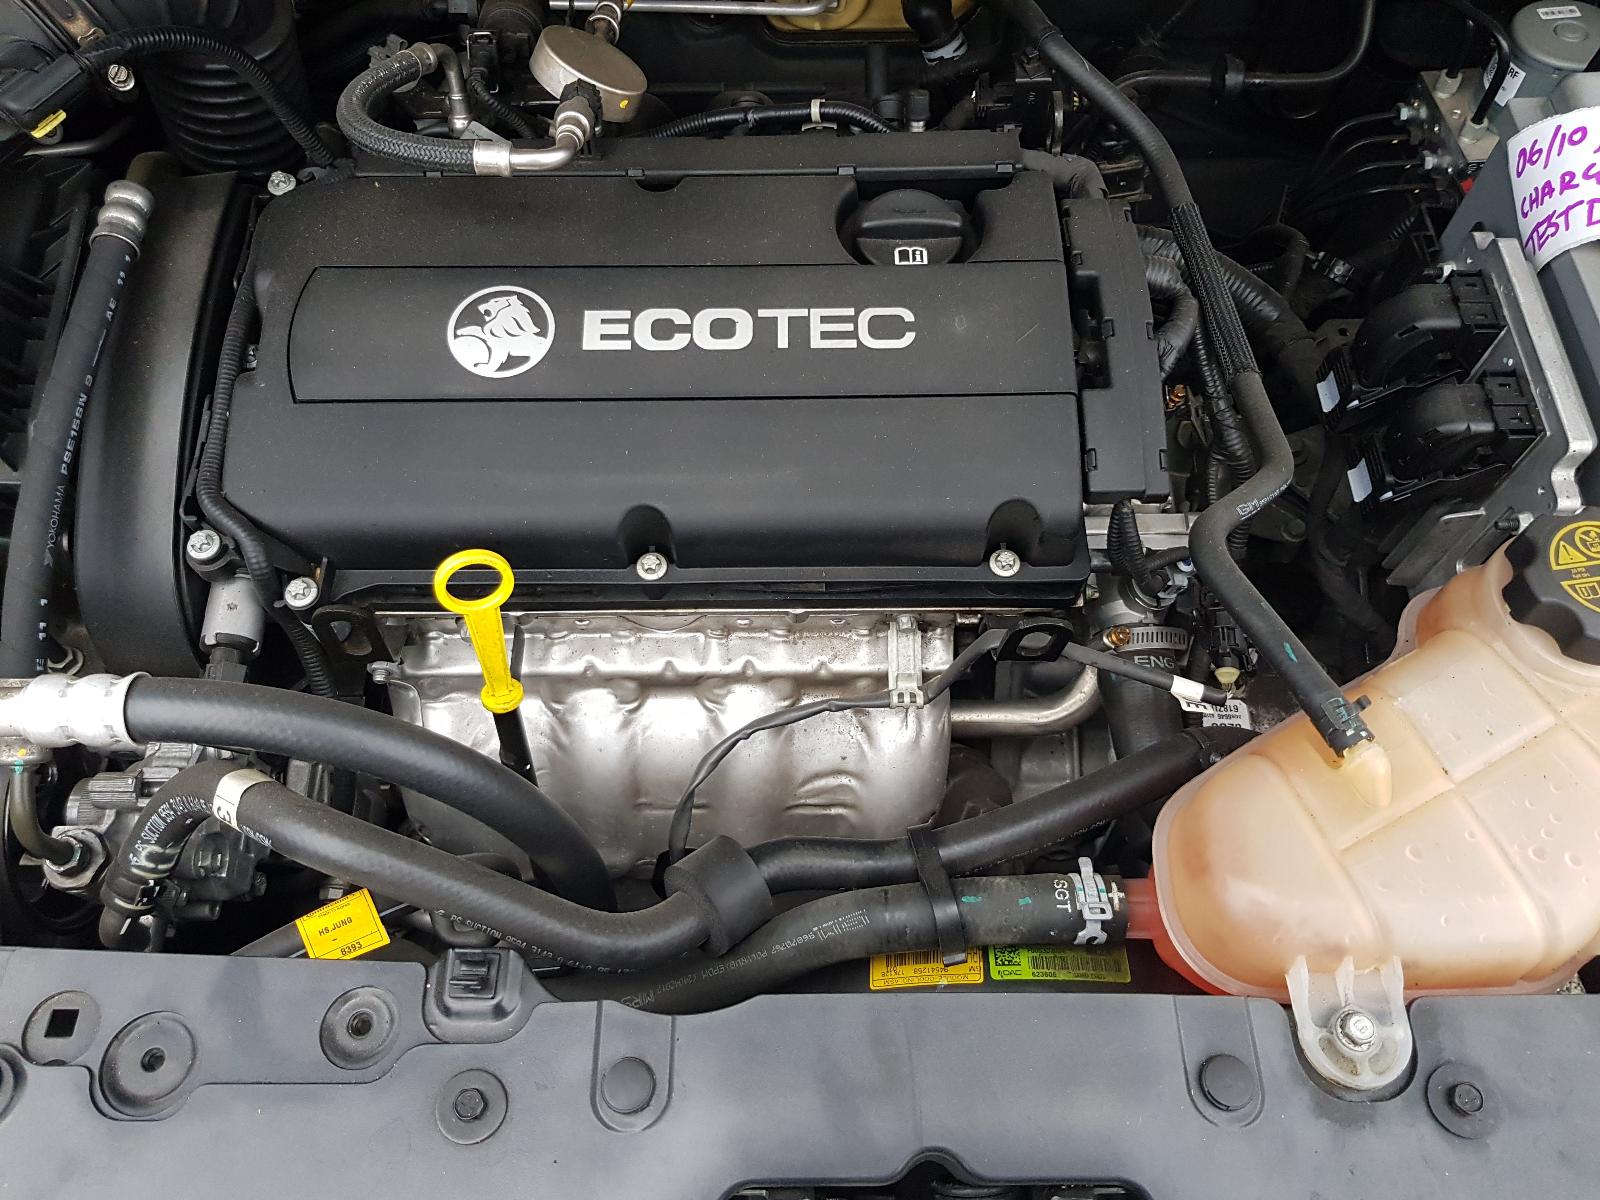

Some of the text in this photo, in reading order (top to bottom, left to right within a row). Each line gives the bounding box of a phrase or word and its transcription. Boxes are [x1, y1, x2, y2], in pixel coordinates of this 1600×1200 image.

[1516, 124, 1588, 179] 06/10
[1524, 200, 1584, 256] TEST
[582, 306, 917, 351] ECOTEC
[47, 484, 66, 549] YOKOHAMA
[1134, 655, 1176, 669] ENG
[1053, 879, 1071, 913] SGT
[340, 941, 363, 956] 8393
